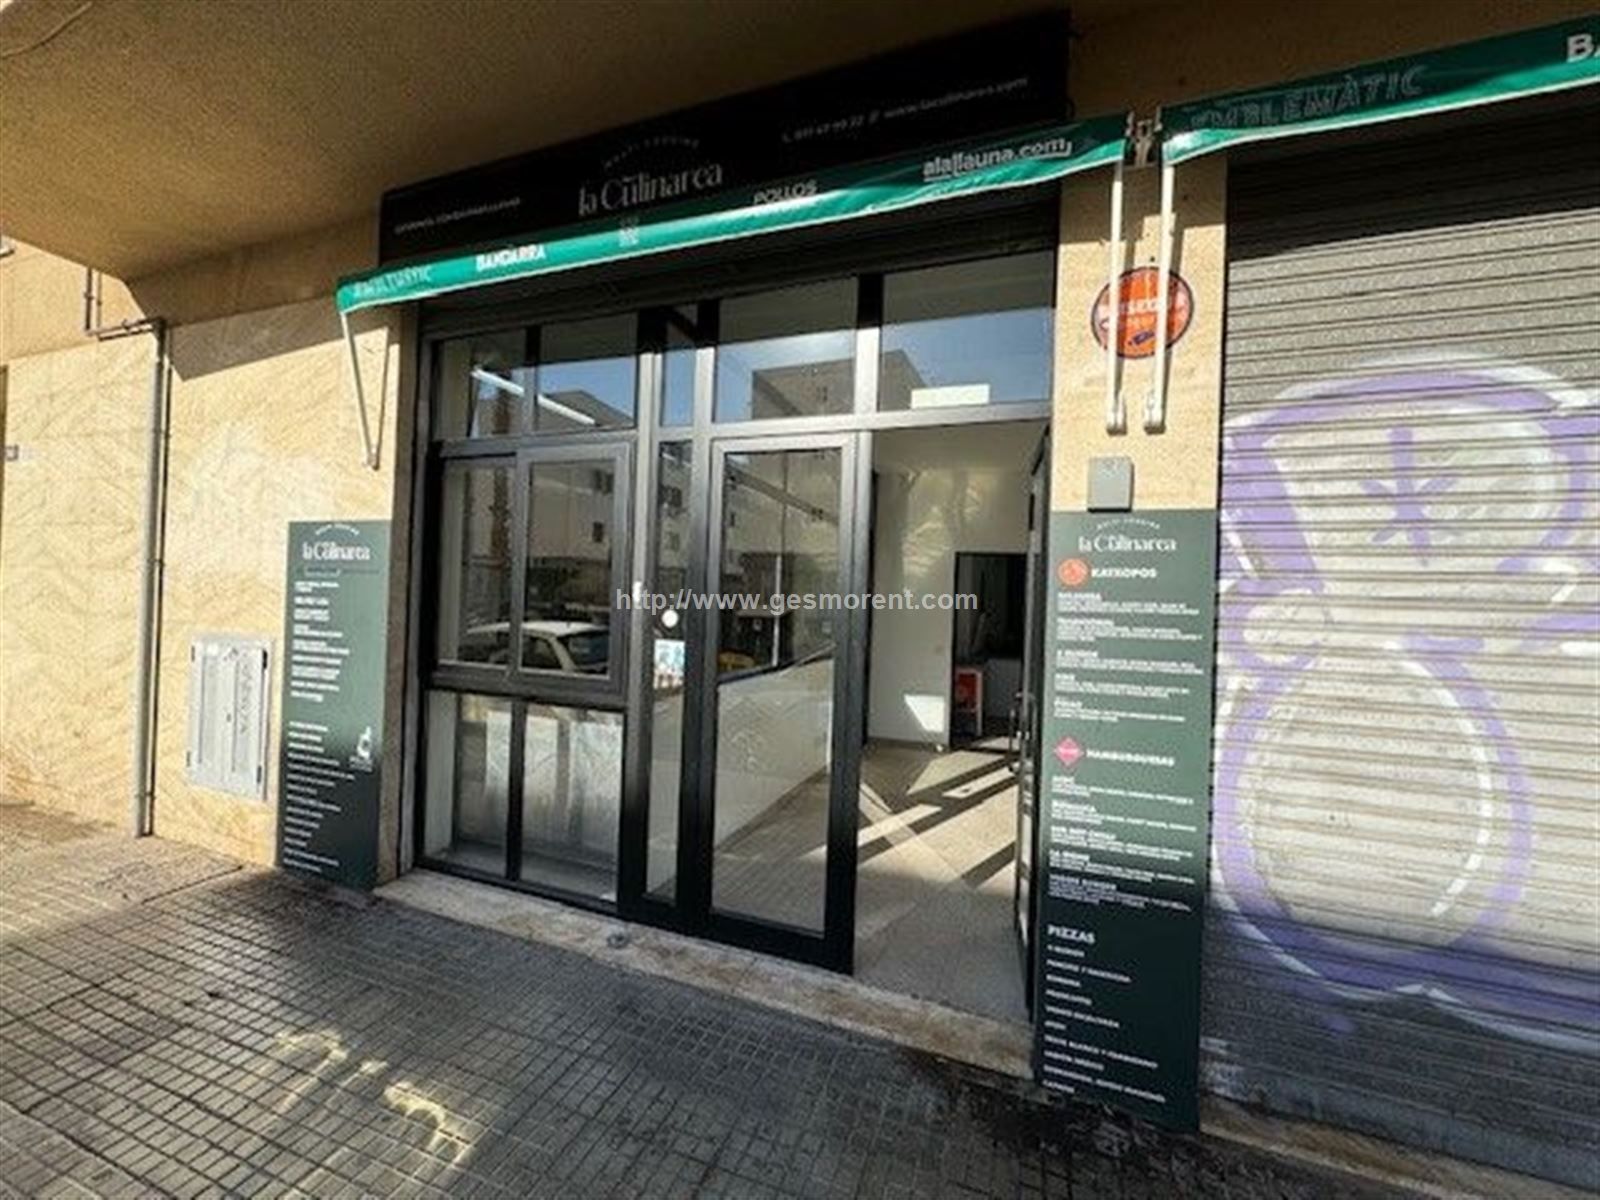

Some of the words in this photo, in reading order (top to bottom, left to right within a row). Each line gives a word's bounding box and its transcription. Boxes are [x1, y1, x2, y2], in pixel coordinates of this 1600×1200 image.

[1567, 33, 1600, 62] B
[578, 186, 598, 216] la
[1046, 923, 1096, 945] PIZZAS
